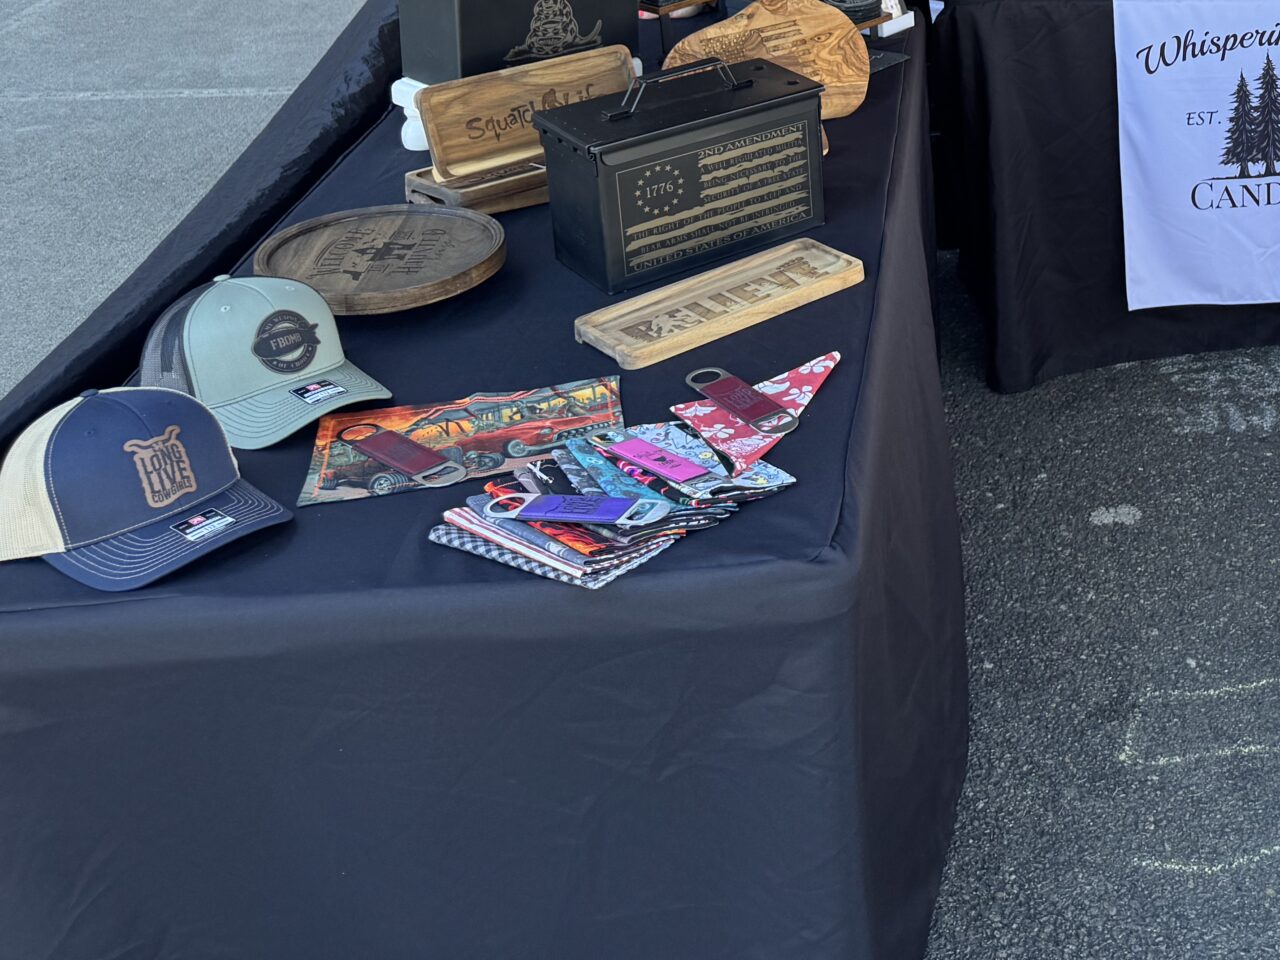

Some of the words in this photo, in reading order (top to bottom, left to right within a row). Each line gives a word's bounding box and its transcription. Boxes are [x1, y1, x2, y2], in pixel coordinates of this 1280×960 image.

[1185, 110, 1223, 127] EST.
[697, 146, 725, 160] 2ND
[725, 123, 805, 152] AMENDMENT
[703, 176, 727, 188] BEING
[731, 163, 773, 181] NECESSARY
[775, 159, 786, 168] TO
[708, 160, 727, 172] WELL
[730, 148, 774, 165] REGULATED
[645, 182, 674, 199] 1776
[702, 185, 741, 202] SECURITY
[764, 172, 781, 185] FREE
[633, 230, 651, 241] THE
[652, 222, 680, 235] RIGHT
[683, 216, 695, 226] OF
[699, 210, 715, 220] THE
[717, 201, 746, 216] PEOPLE
[749, 196, 762, 206] TO
[763, 190, 782, 202] KEEP
[784, 184, 803, 195] AND
[633, 250, 683, 272] UNITED
[684, 235, 731, 255] STATES
[733, 230, 749, 241] OF
[751, 211, 808, 234] AMERICA
[640, 243, 663, 255] BEAR
[665, 235, 689, 248] ARMS
[690, 227, 716, 240] SHALL
[718, 219, 738, 230] NOT
[740, 214, 750, 224] BE
[306, 228, 377, 280] WELCOME
[269, 332, 302, 351] FBOMB
[140, 443, 183, 475] LONG
[147, 460, 189, 494] LIVE
[151, 478, 193, 503] COWGIRLS
